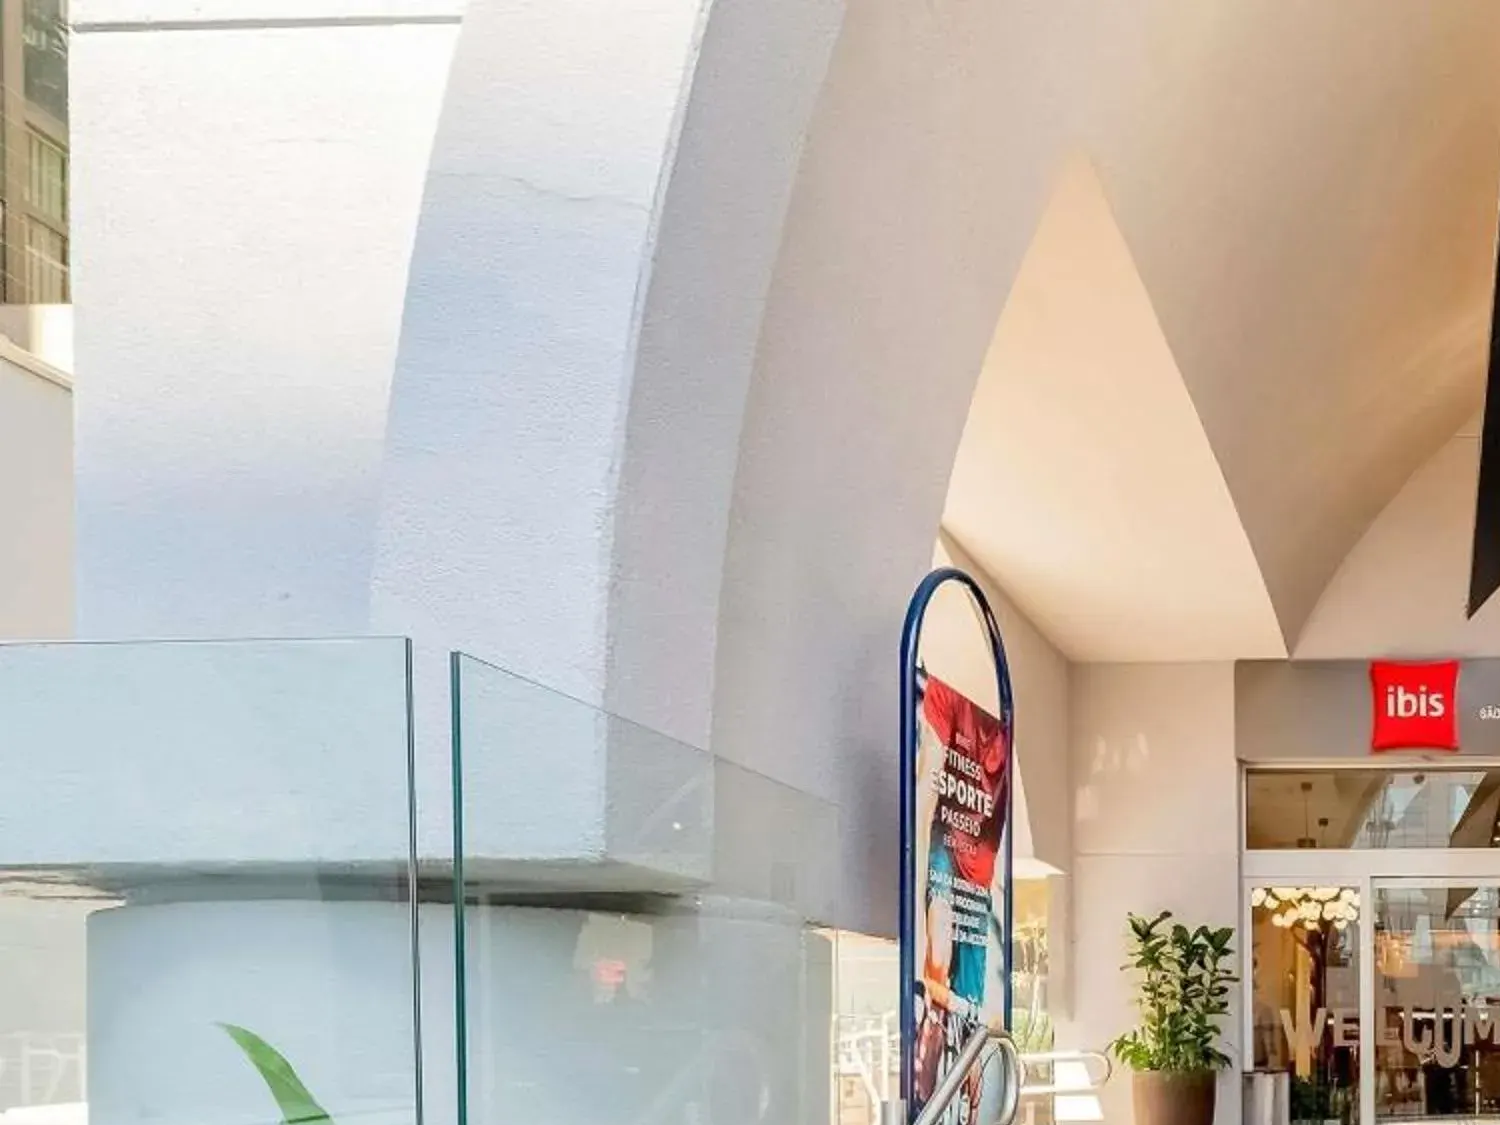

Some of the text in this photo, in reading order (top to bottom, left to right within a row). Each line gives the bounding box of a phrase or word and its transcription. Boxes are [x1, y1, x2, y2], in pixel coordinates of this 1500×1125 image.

[1386, 685, 1445, 718] ibis
[943, 745, 981, 781] FITNESS
[929, 767, 993, 819] ESPORTE
[940, 804, 981, 838] PASSEIO
